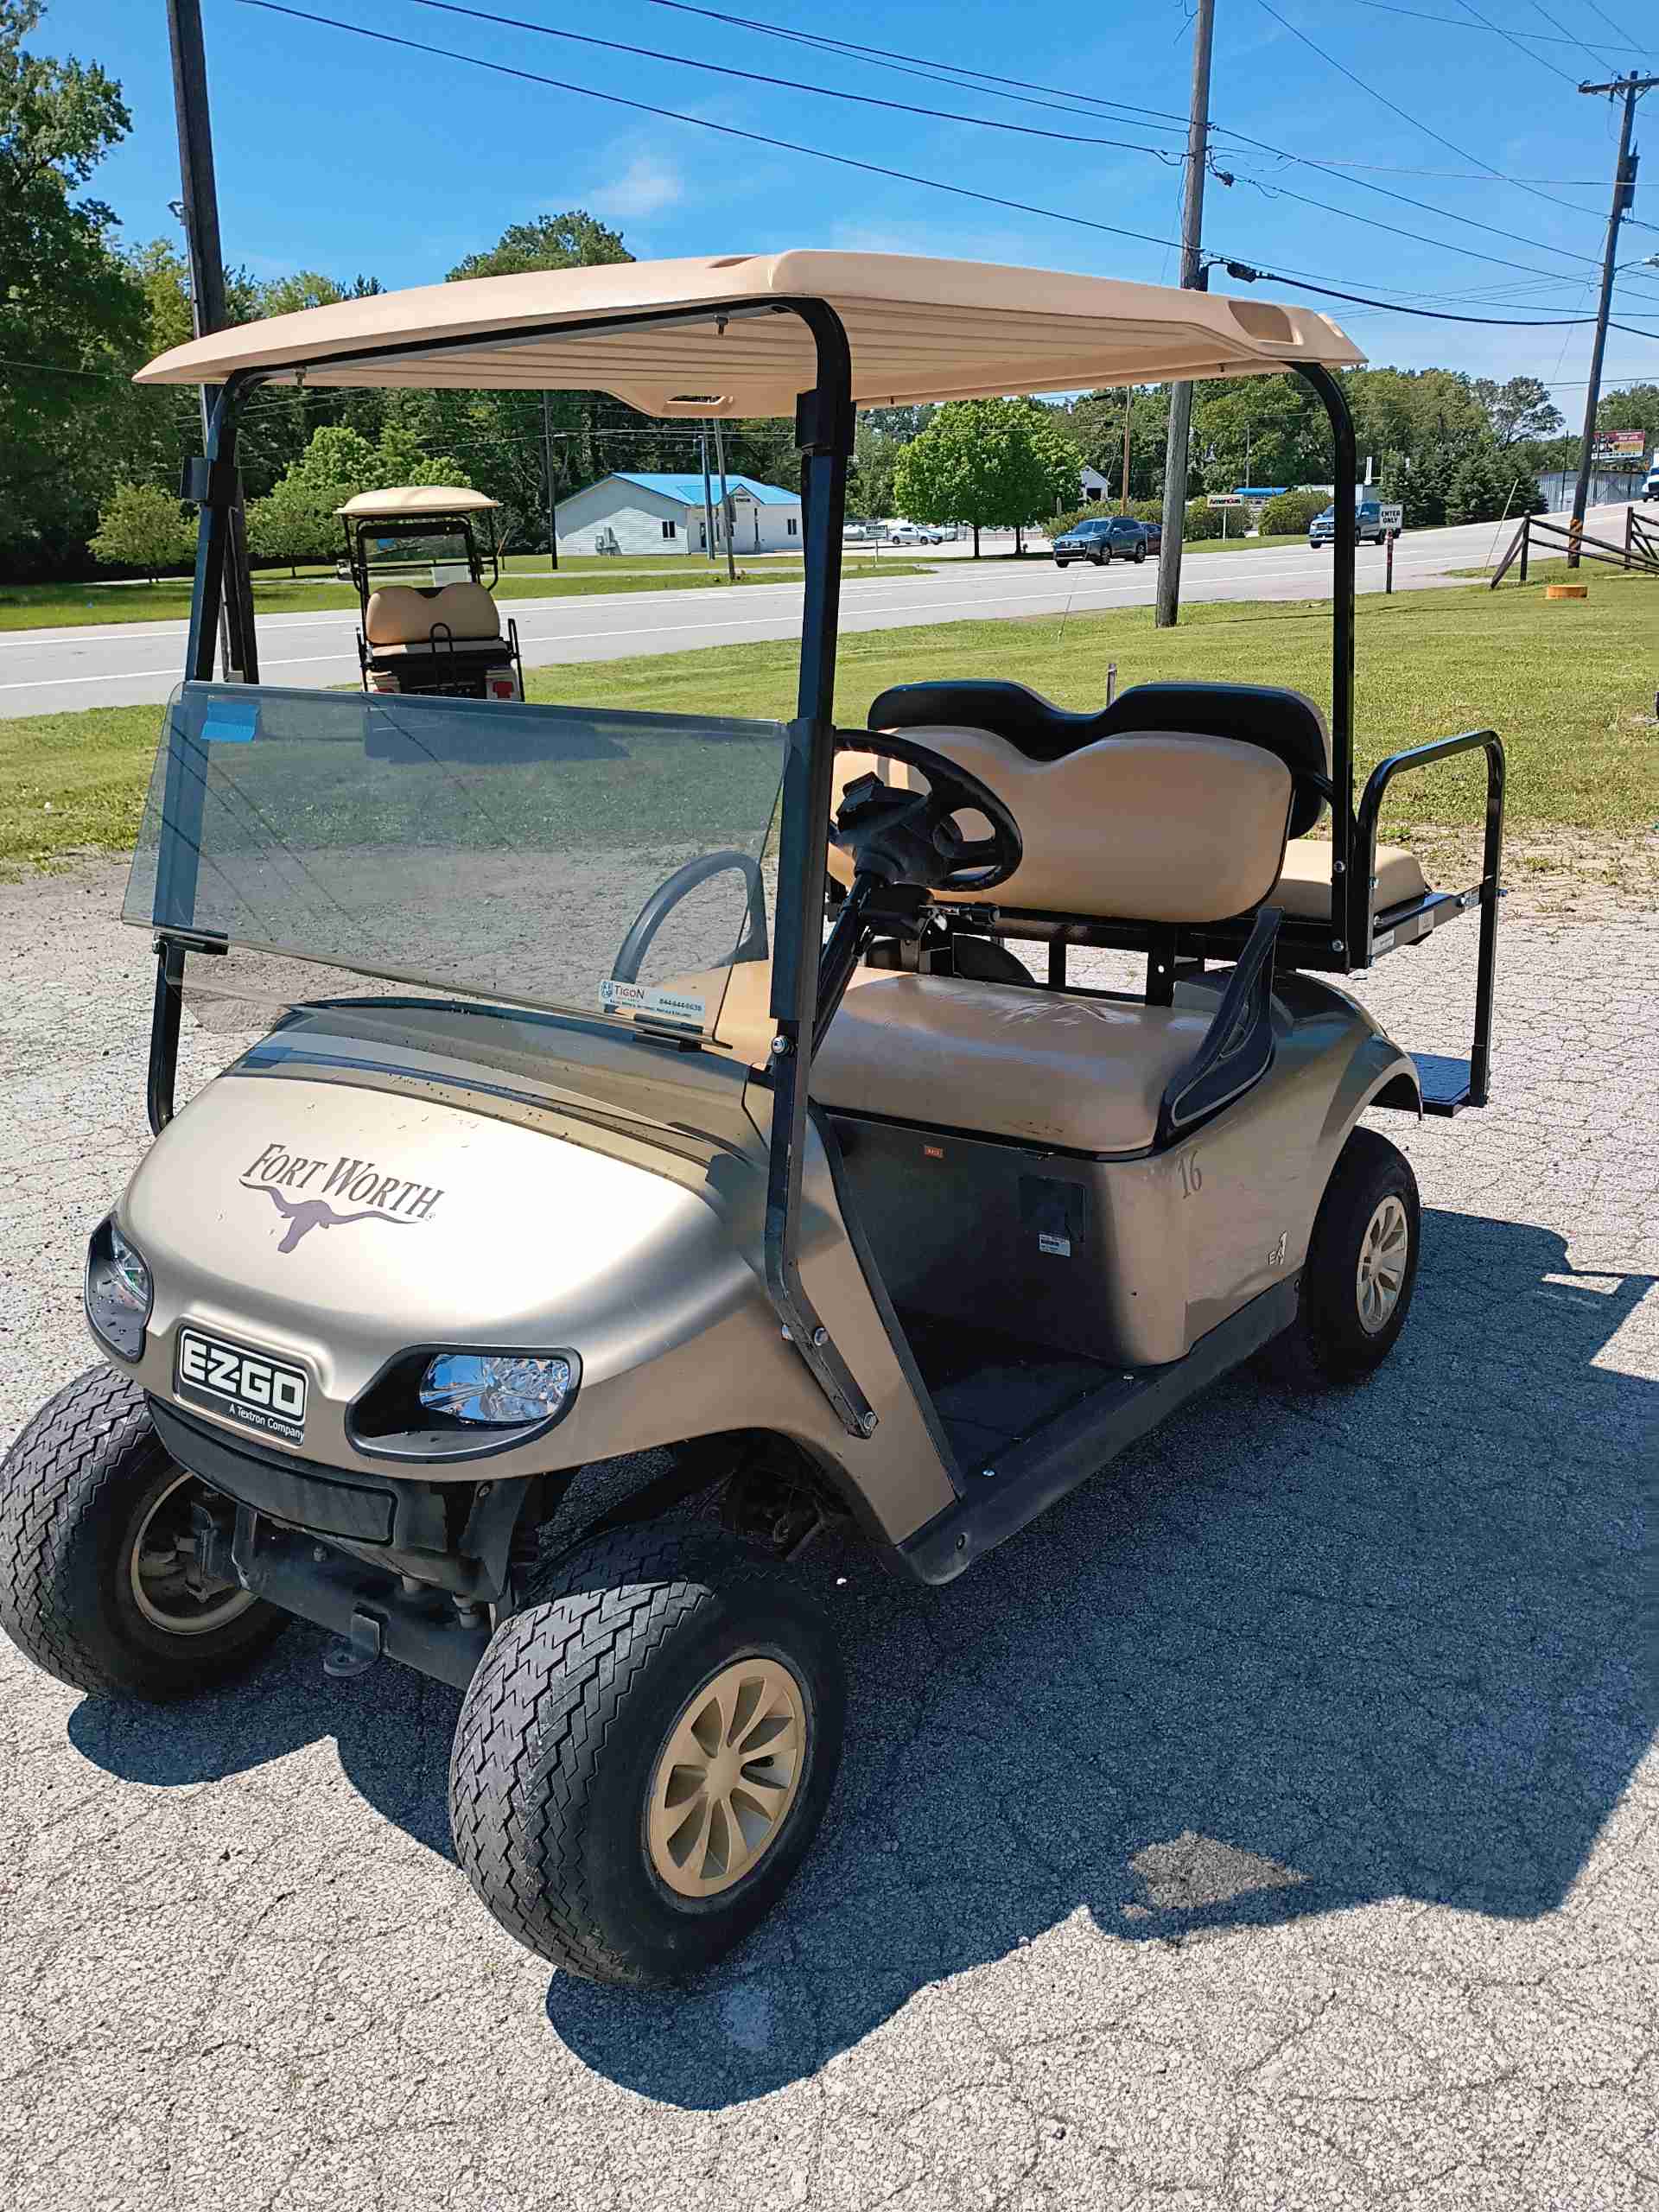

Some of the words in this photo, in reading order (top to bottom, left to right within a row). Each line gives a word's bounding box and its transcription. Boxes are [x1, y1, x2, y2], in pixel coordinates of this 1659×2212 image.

[241, 1142, 328, 1189] FORT
[321, 1156, 446, 1219] WORTH
[1176, 1148, 1203, 1199] 16
[228, 1402, 236, 1415] A
[237, 1405, 266, 1426] Textron
[267, 1417, 305, 1445] Company
